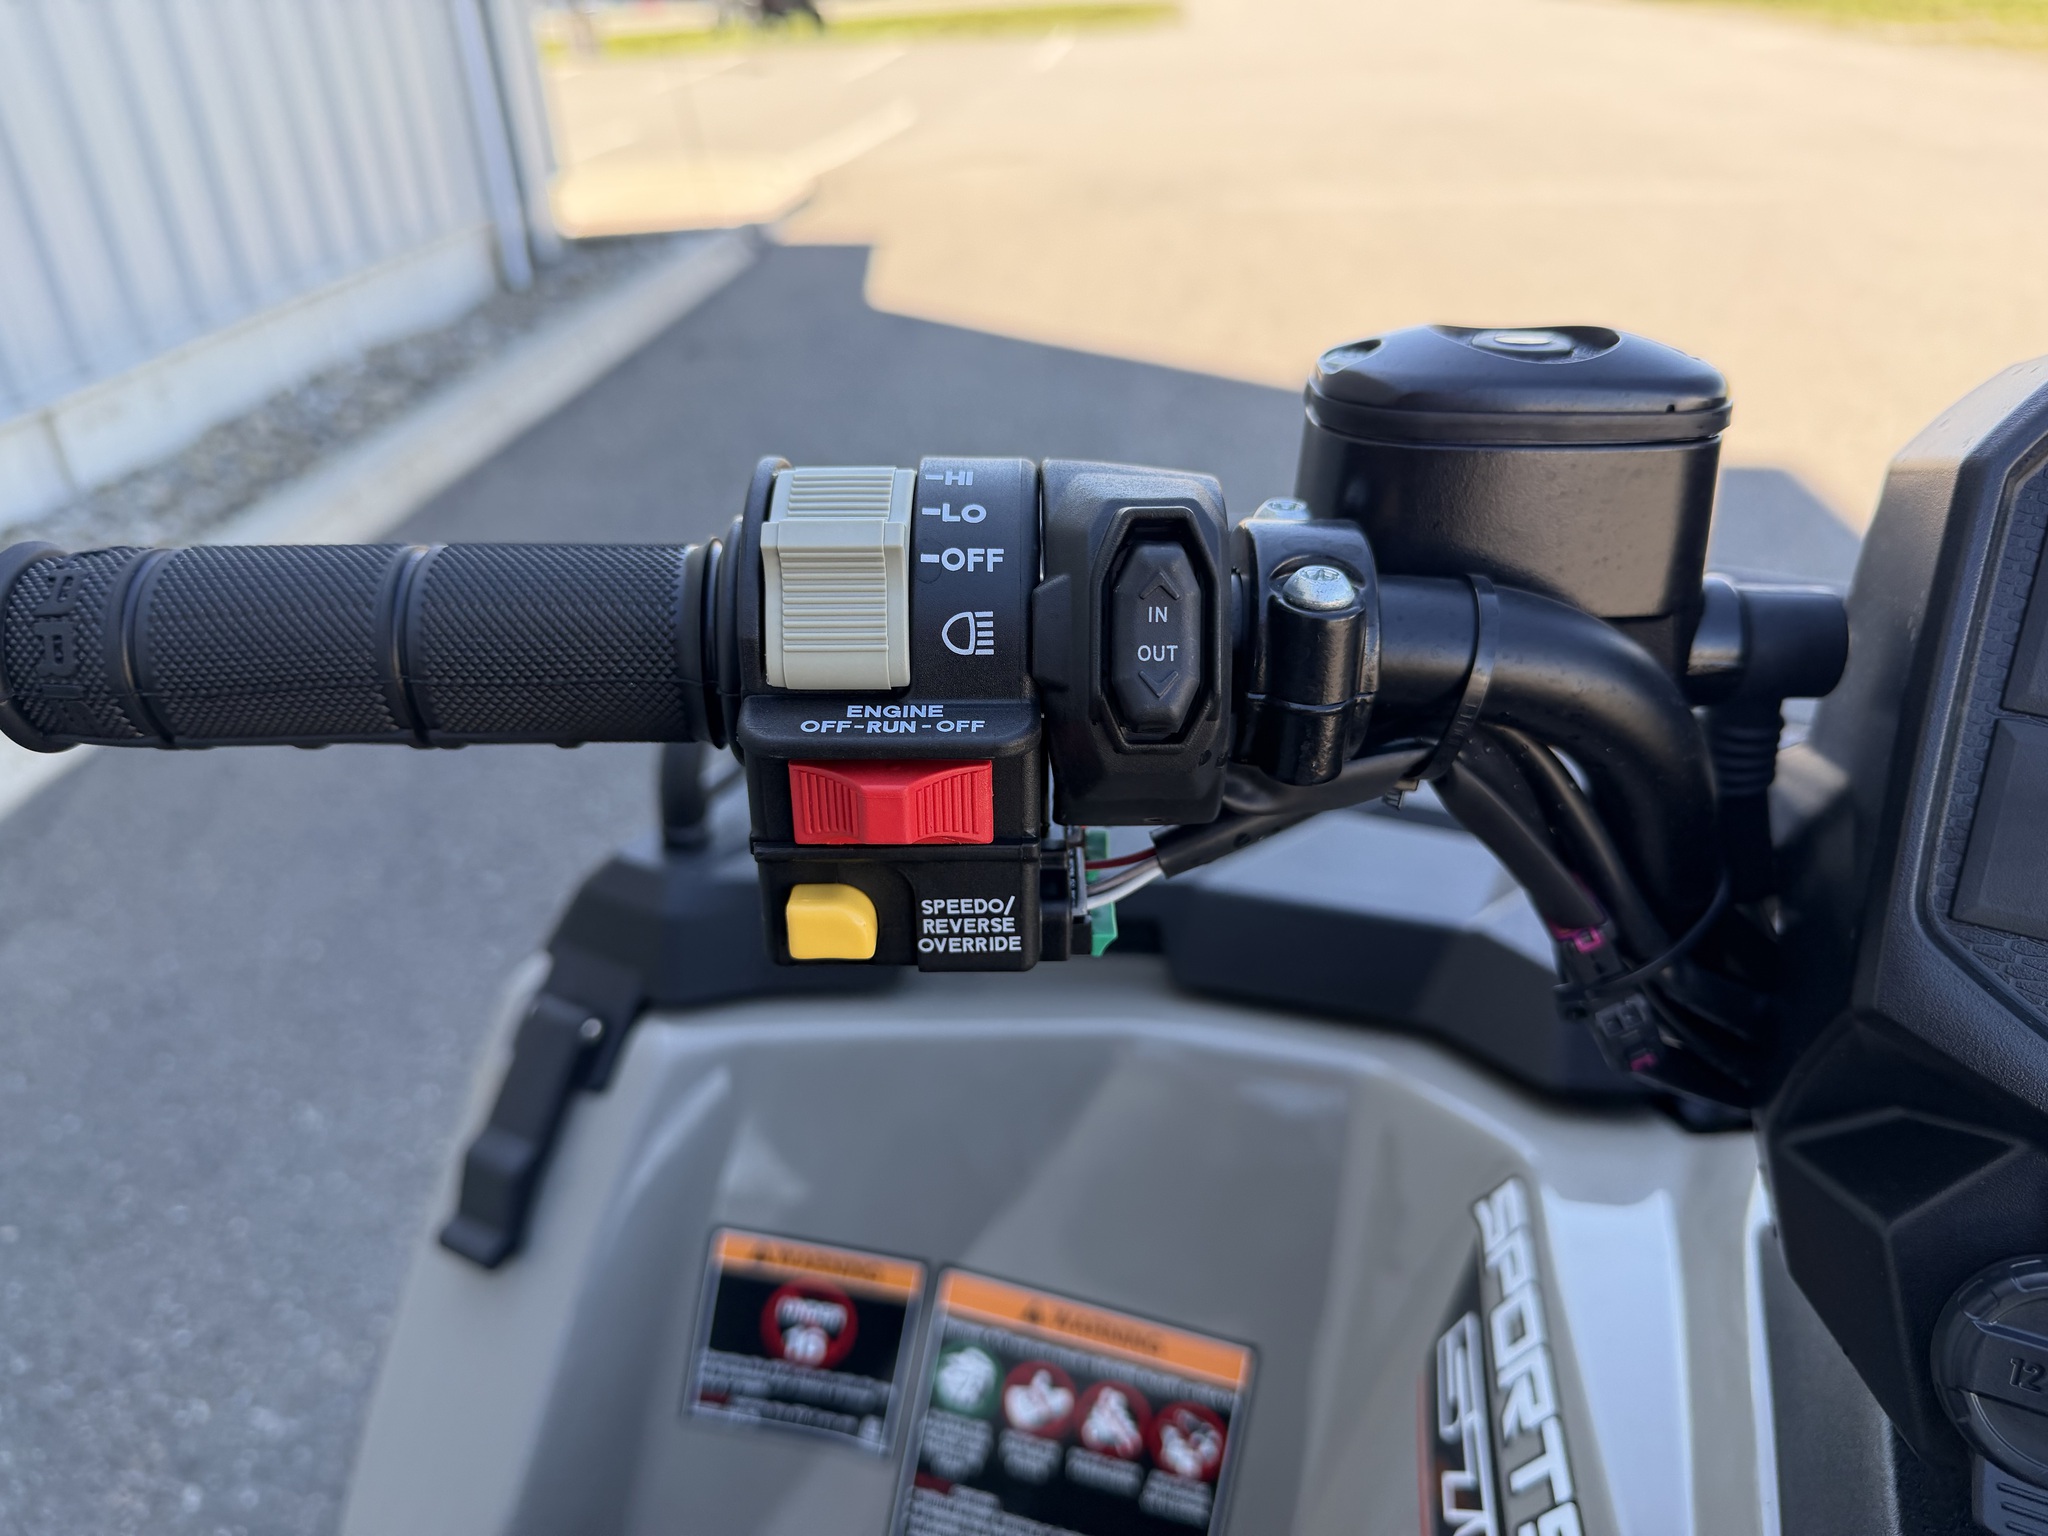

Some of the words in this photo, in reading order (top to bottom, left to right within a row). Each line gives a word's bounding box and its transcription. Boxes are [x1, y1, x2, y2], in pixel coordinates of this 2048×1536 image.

[945, 471, 973, 485] HI
[942, 503, 987, 523] LO
[941, 547, 1004, 572] OFF
[1148, 606, 1168, 623] IN
[1137, 644, 1178, 662] OUT
[846, 704, 944, 718] ENGINE
[921, 895, 1016, 916] SPEEDO/
[923, 917, 1016, 934] REVERSE
[918, 936, 1022, 953] OVERRIDE
